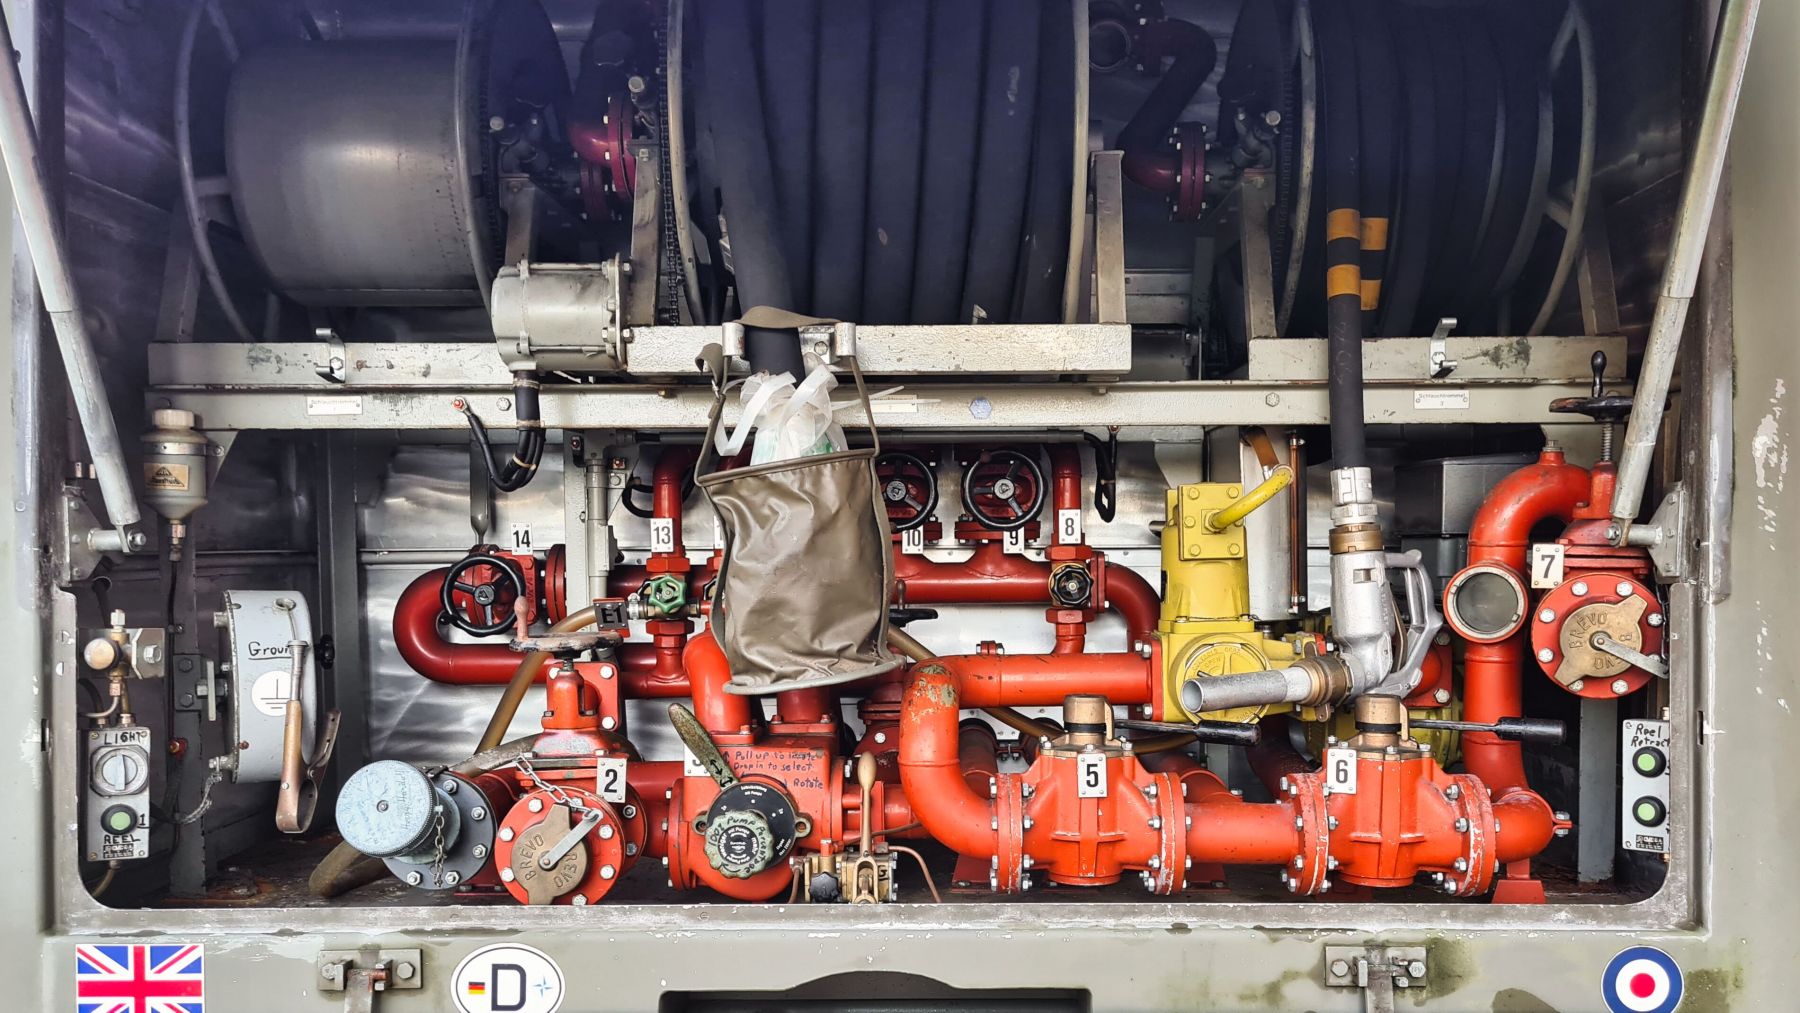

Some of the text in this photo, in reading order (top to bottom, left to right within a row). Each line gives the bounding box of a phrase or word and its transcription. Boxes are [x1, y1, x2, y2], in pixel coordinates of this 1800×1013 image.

[653, 526, 671, 545] 13
[1065, 517, 1075, 536] 8
[512, 529, 531, 548] 14
[904, 529, 921, 546] 10
[1009, 529, 1019, 546] 9
[1541, 554, 1556, 579] 7
[601, 606, 623, 624] E1
[1568, 612, 1608, 649] BREVO
[104, 731, 141, 745] LIGHT
[1635, 723, 1662, 739] Reel
[735, 750, 753, 761] Pull
[773, 750, 785, 760] to
[768, 761, 778, 770] to
[780, 760, 813, 772] select
[1086, 763, 1099, 788] 5
[1335, 759, 1349, 784] 6
[603, 768, 618, 793] 2
[793, 776, 824, 790] Rotate
[103, 833, 141, 845] REEL
[519, 833, 545, 881] BREVO
[491, 963, 527, 1012] D
